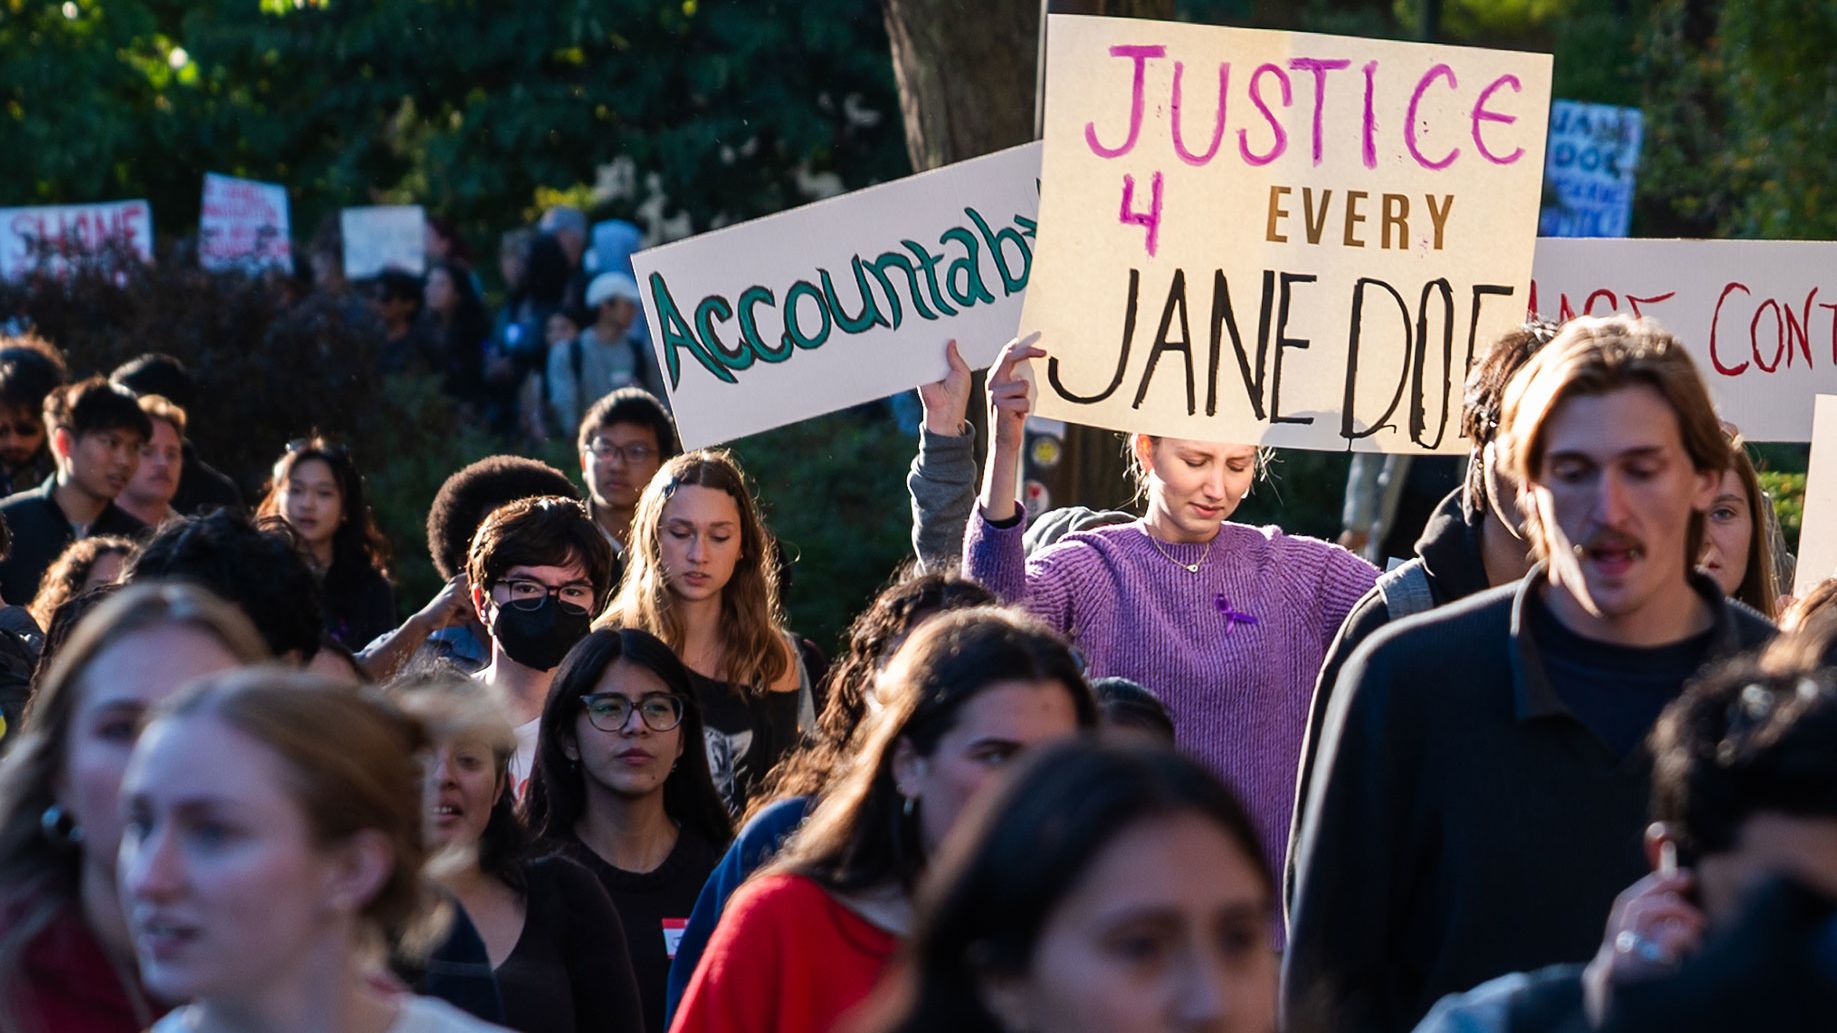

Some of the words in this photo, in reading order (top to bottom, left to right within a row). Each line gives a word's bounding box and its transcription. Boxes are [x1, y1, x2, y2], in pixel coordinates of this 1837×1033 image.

[1084, 44, 1526, 171] JUSTICE
[1118, 170, 1165, 259] 4
[1265, 185, 1455, 252] EVERY
[648, 206, 1039, 392] Accountab
[1047, 267, 1318, 425] JANE
